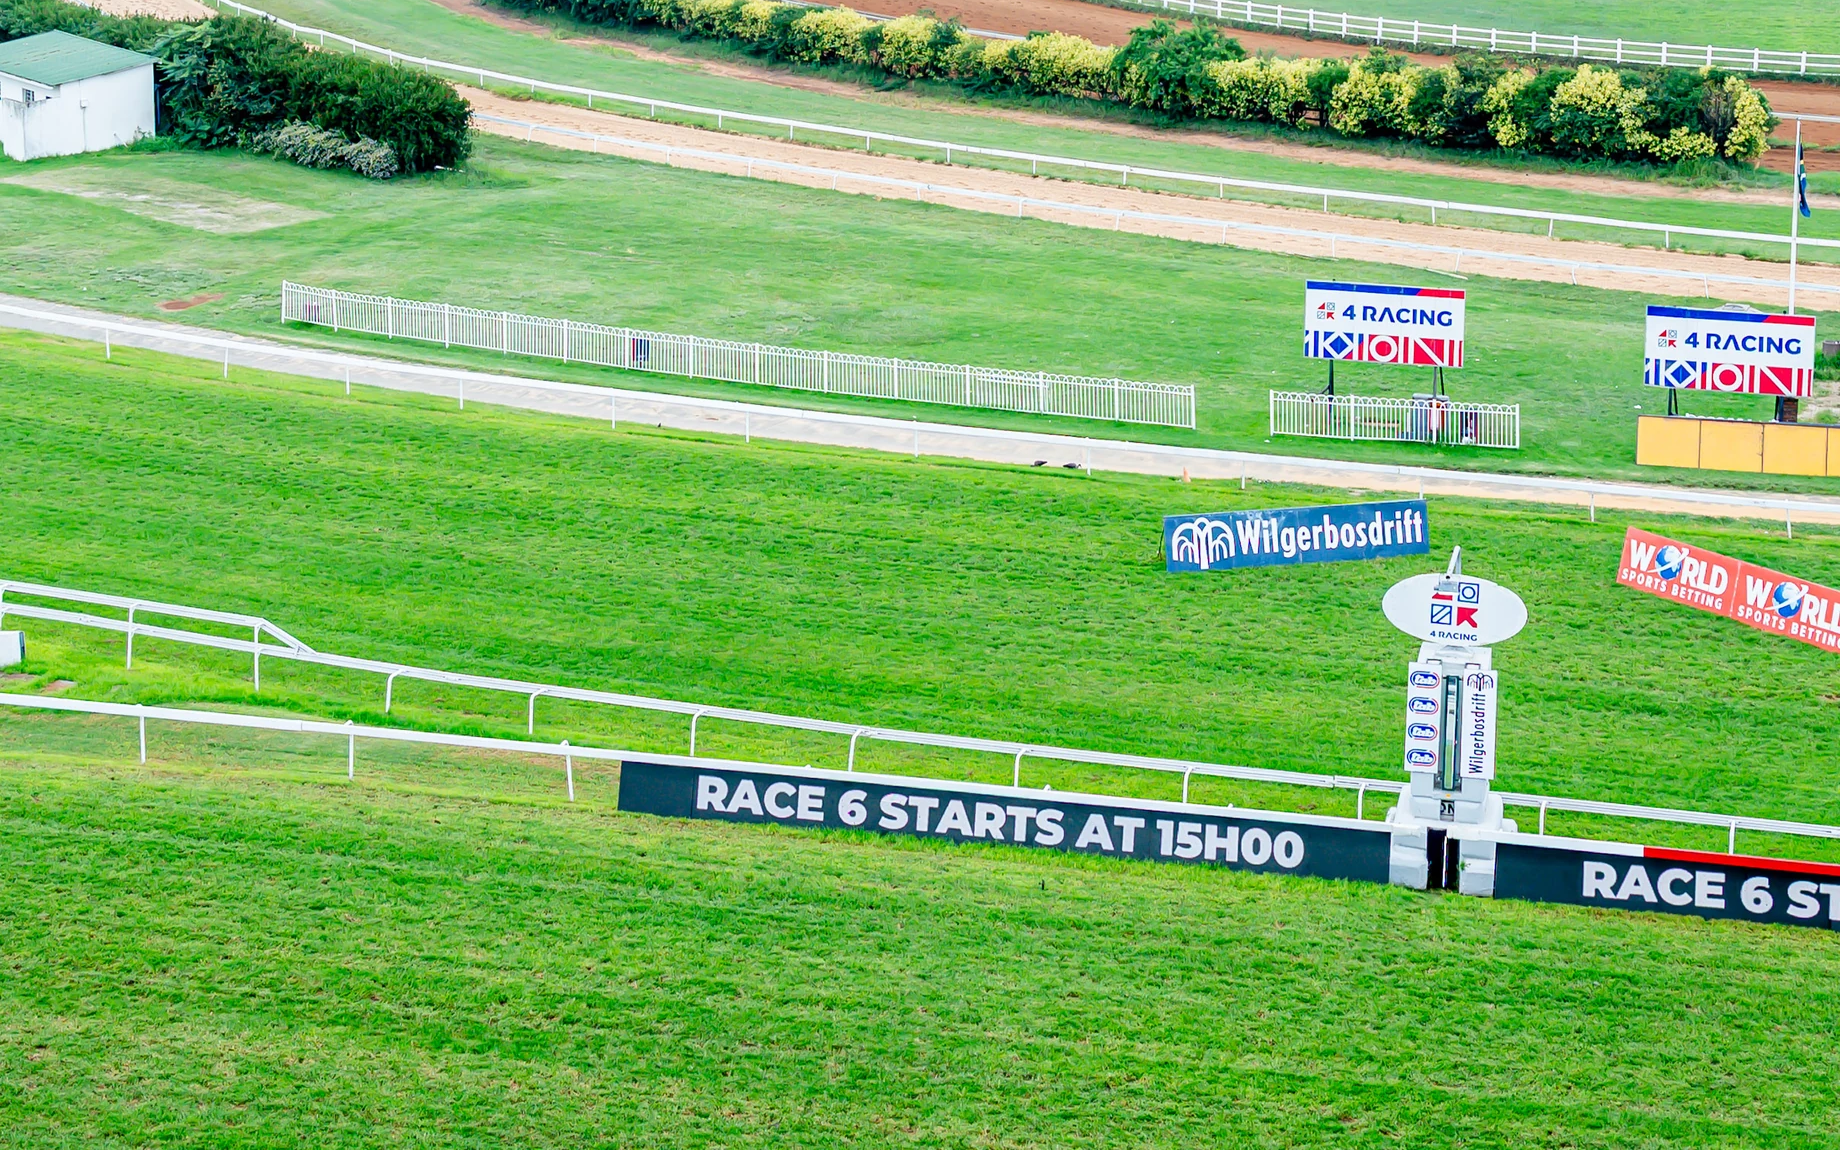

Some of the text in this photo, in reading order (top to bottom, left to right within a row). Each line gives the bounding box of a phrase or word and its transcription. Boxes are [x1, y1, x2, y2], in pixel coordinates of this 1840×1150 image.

[1342, 304, 1453, 327] 4 RACING
[1684, 332, 1801, 355] 4 RACING
[1236, 508, 1423, 558] Wilgerbosdrift
[1621, 568, 1723, 610] SPORTS BETTING
[1630, 538, 1729, 595] WORLD
[1438, 631, 1478, 642] RACING
[1737, 605, 1786, 631] SPORTS
[1468, 693, 1487, 774] Wilgerbosdrift
[696, 774, 1305, 869] RACE 6 STARTS AT 15H00
[1582, 860, 1725, 909] RACE
[1740, 876, 1774, 914] 6
